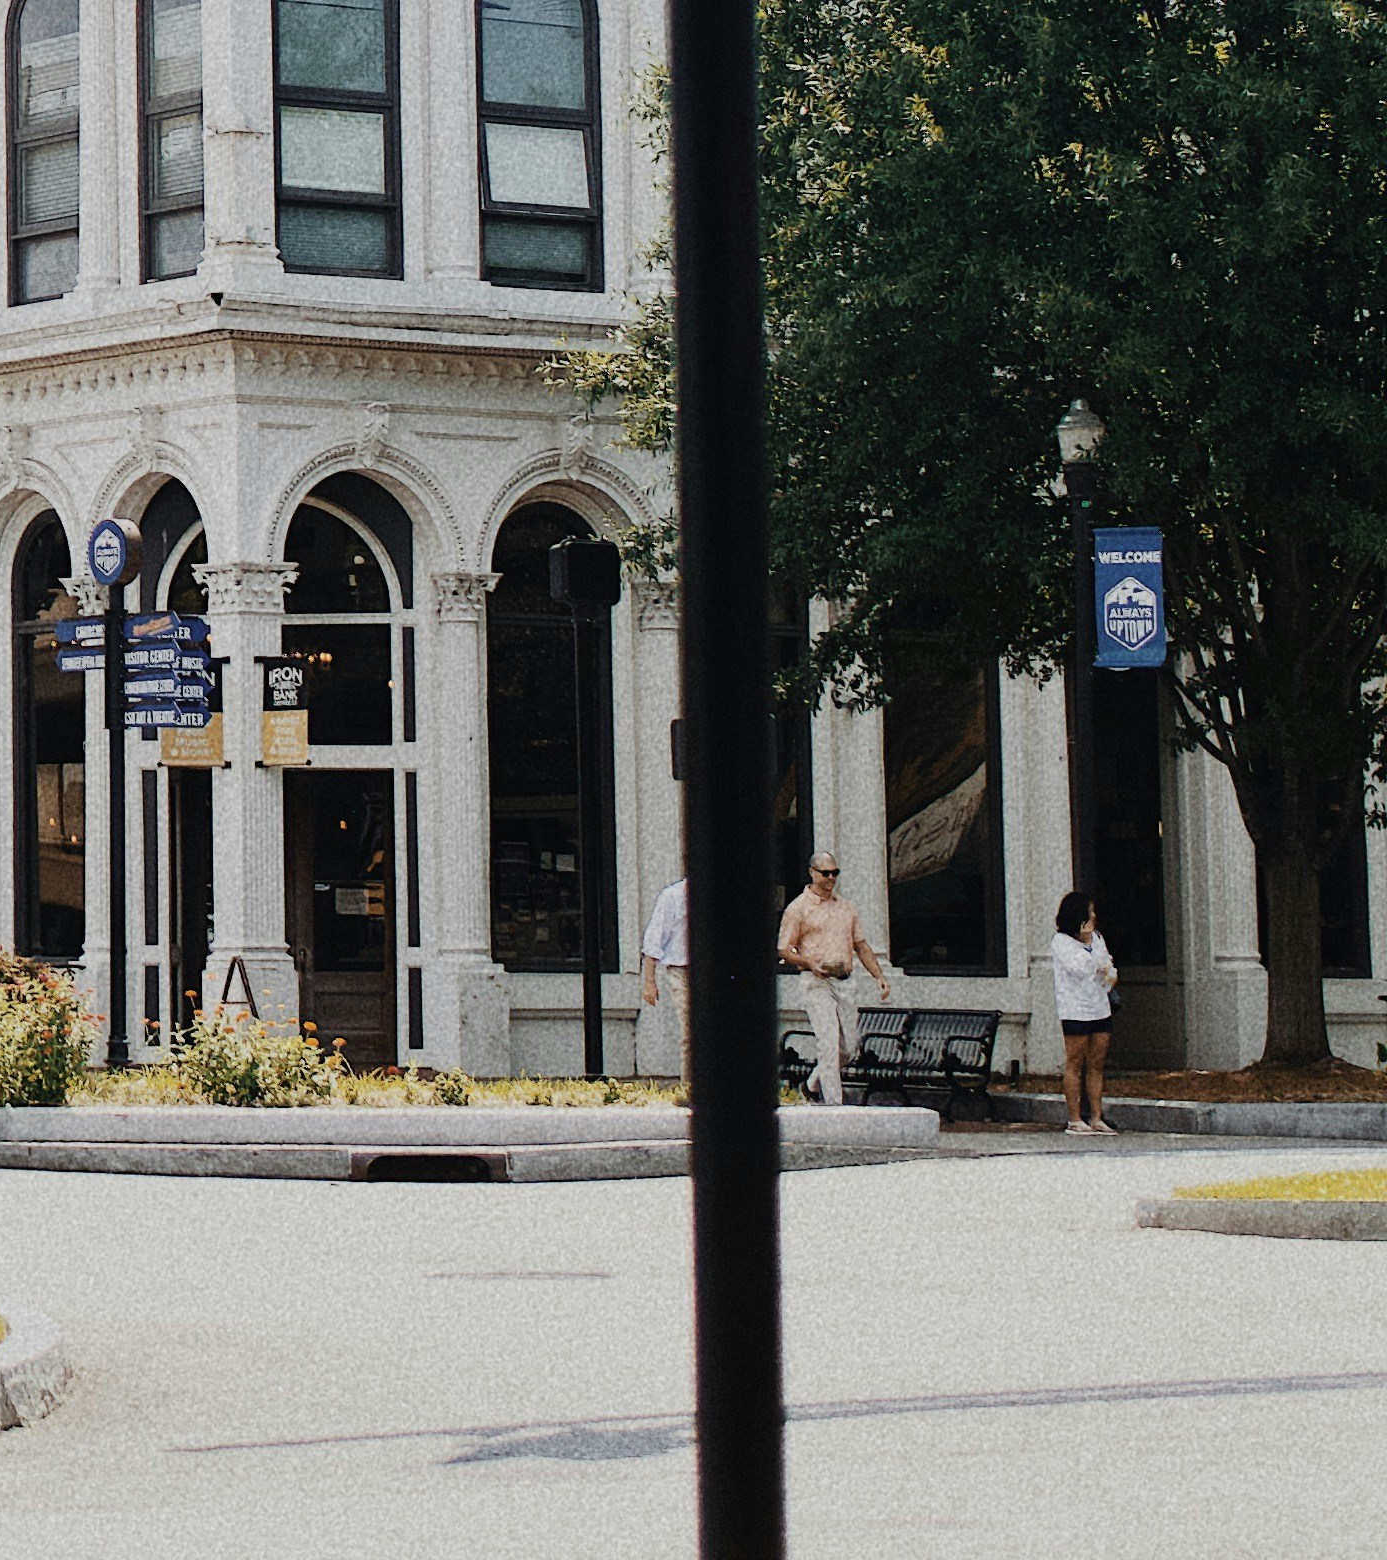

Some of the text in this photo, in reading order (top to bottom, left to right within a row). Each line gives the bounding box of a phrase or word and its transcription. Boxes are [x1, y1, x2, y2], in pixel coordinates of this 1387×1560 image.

[1098, 550, 1162, 564] WELCOME
[1108, 607, 1152, 619] ALWAYS
[1108, 619, 1153, 643] UPTOWN
[268, 666, 303, 687] IRON
[273, 689, 298, 701] BANK
